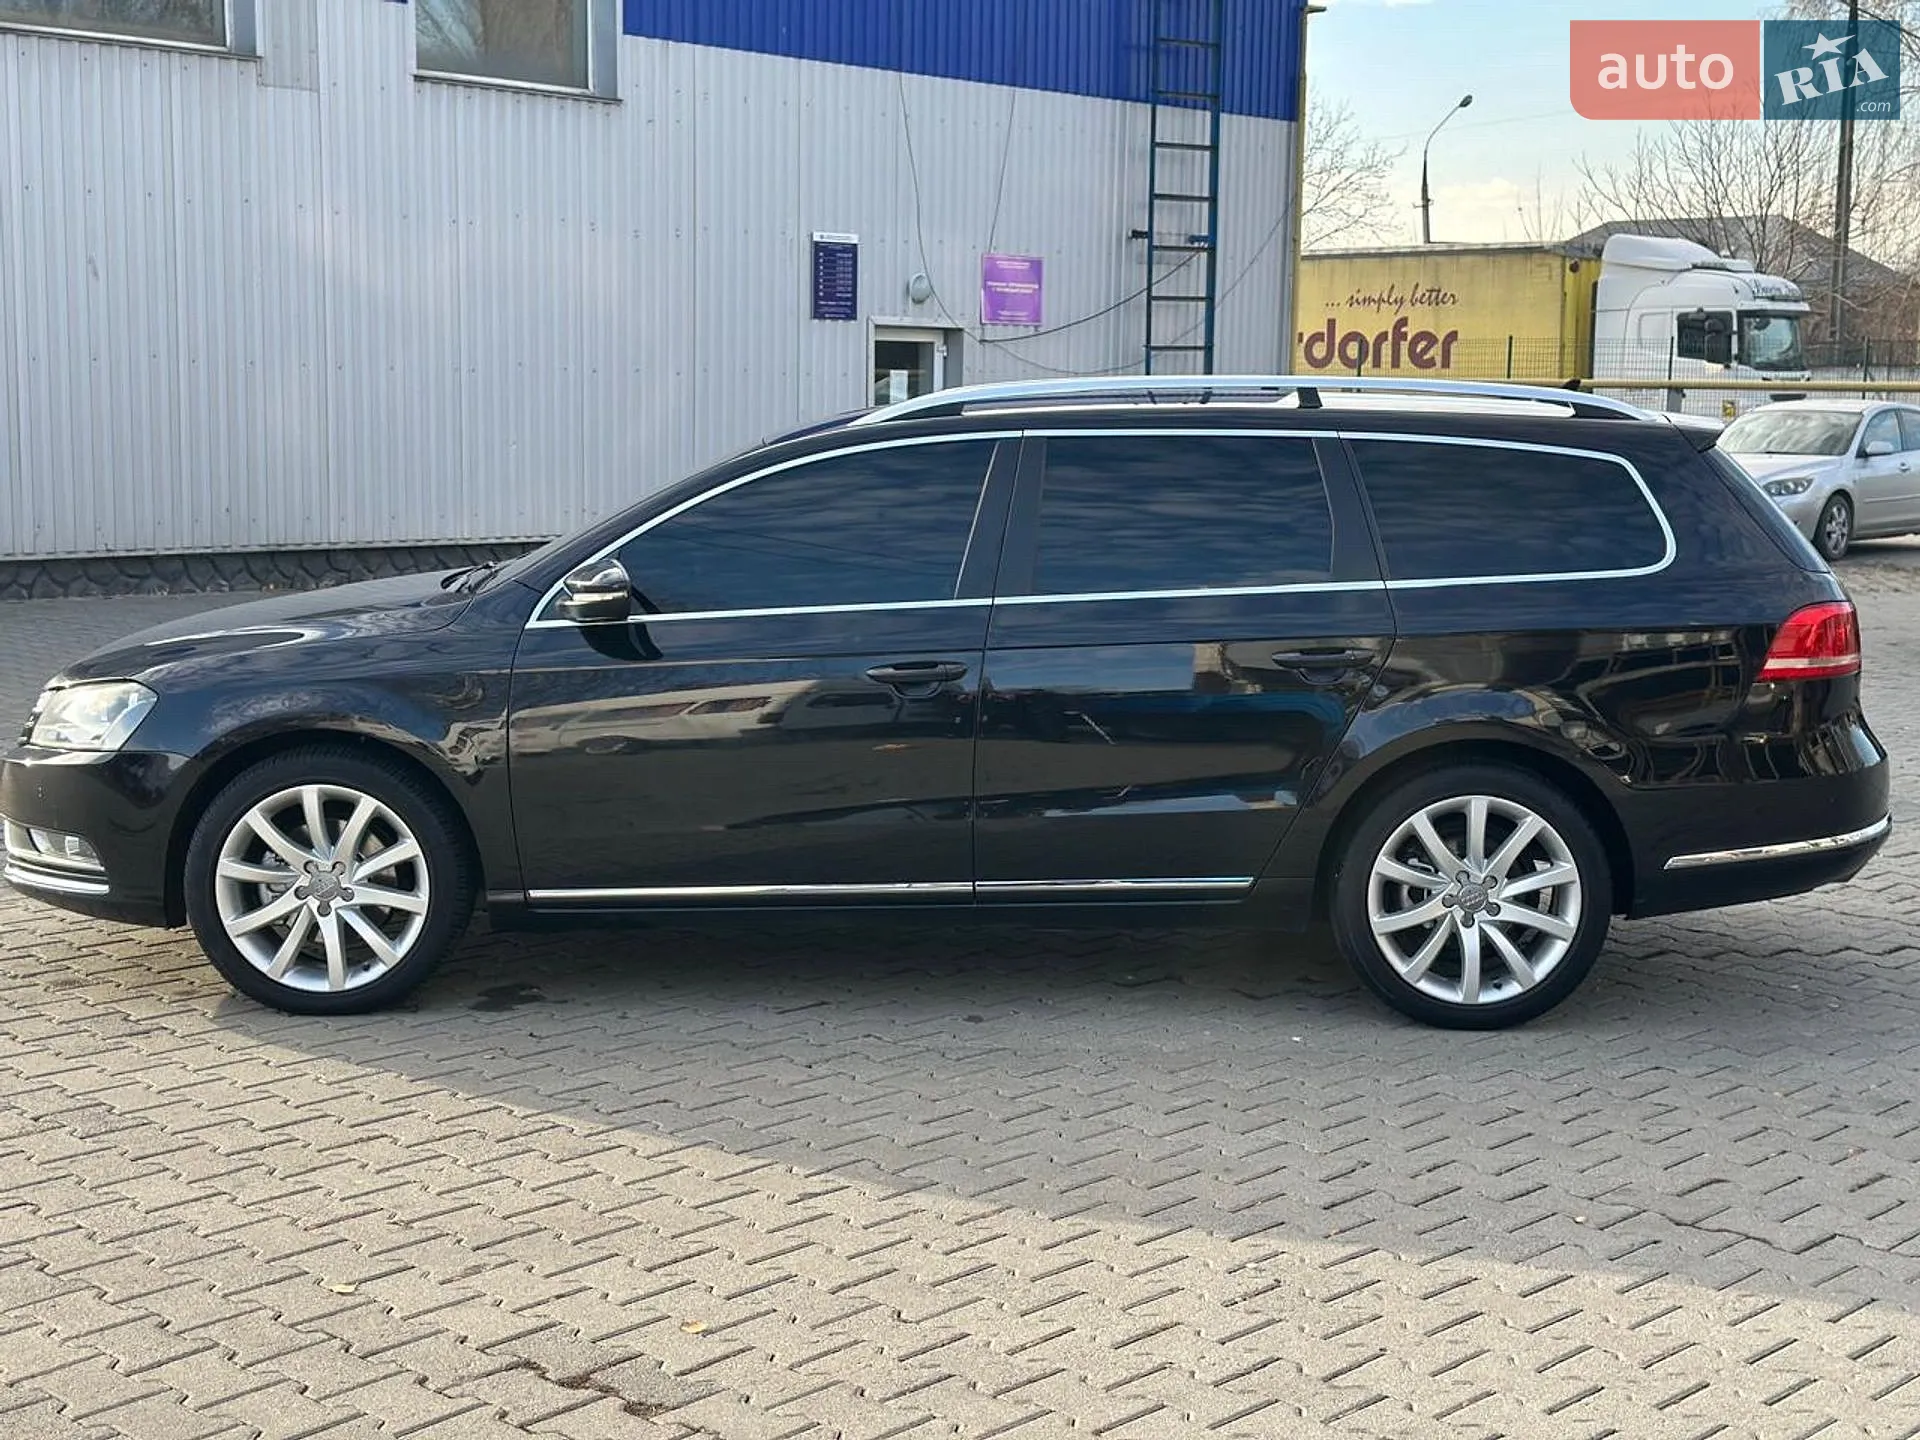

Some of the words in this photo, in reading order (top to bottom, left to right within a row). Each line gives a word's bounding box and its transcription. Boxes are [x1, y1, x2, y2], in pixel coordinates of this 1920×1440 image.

[1346, 284, 1405, 316] simply
[1410, 282, 1459, 307] better
[1297, 316, 1459, 369] dorfer
